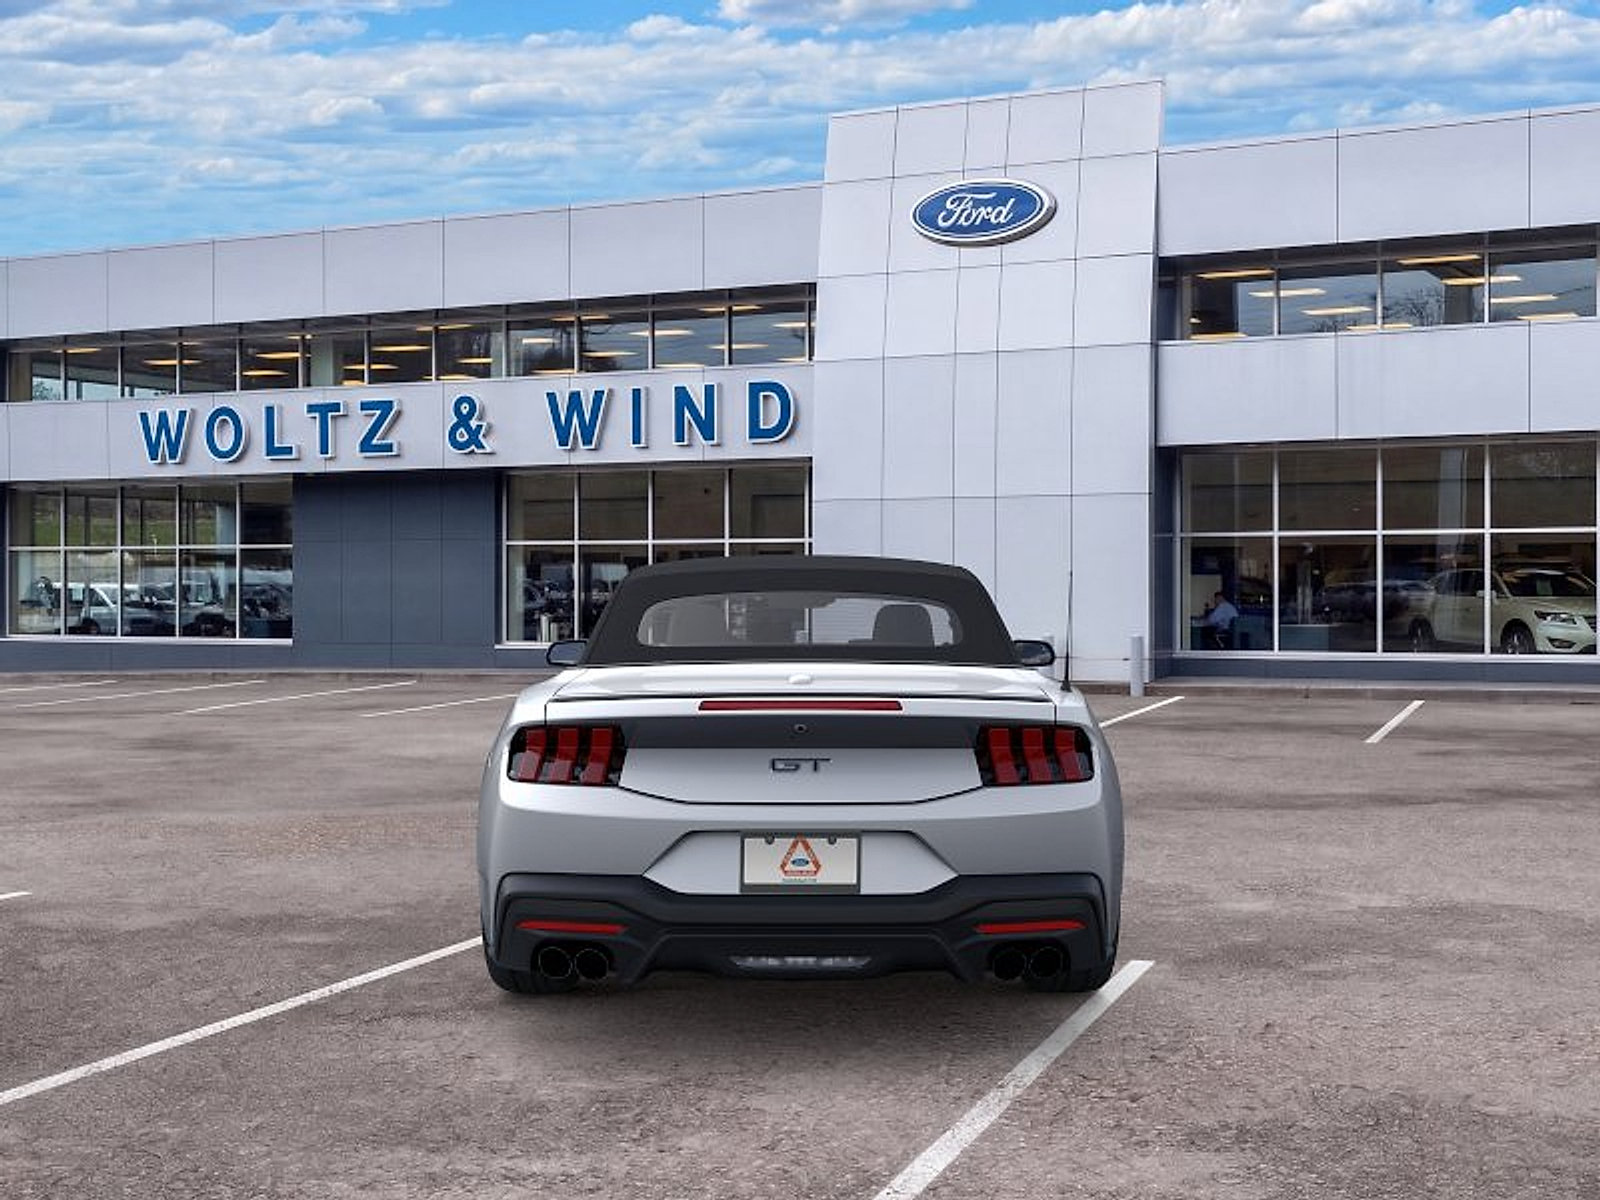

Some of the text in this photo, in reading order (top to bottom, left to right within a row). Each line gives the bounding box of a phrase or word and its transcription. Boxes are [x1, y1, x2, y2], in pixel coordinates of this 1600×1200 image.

[937, 192, 1015, 227] Ford
[138, 379, 795, 463] WOLTZ & WIND
[770, 757, 832, 772] GT
